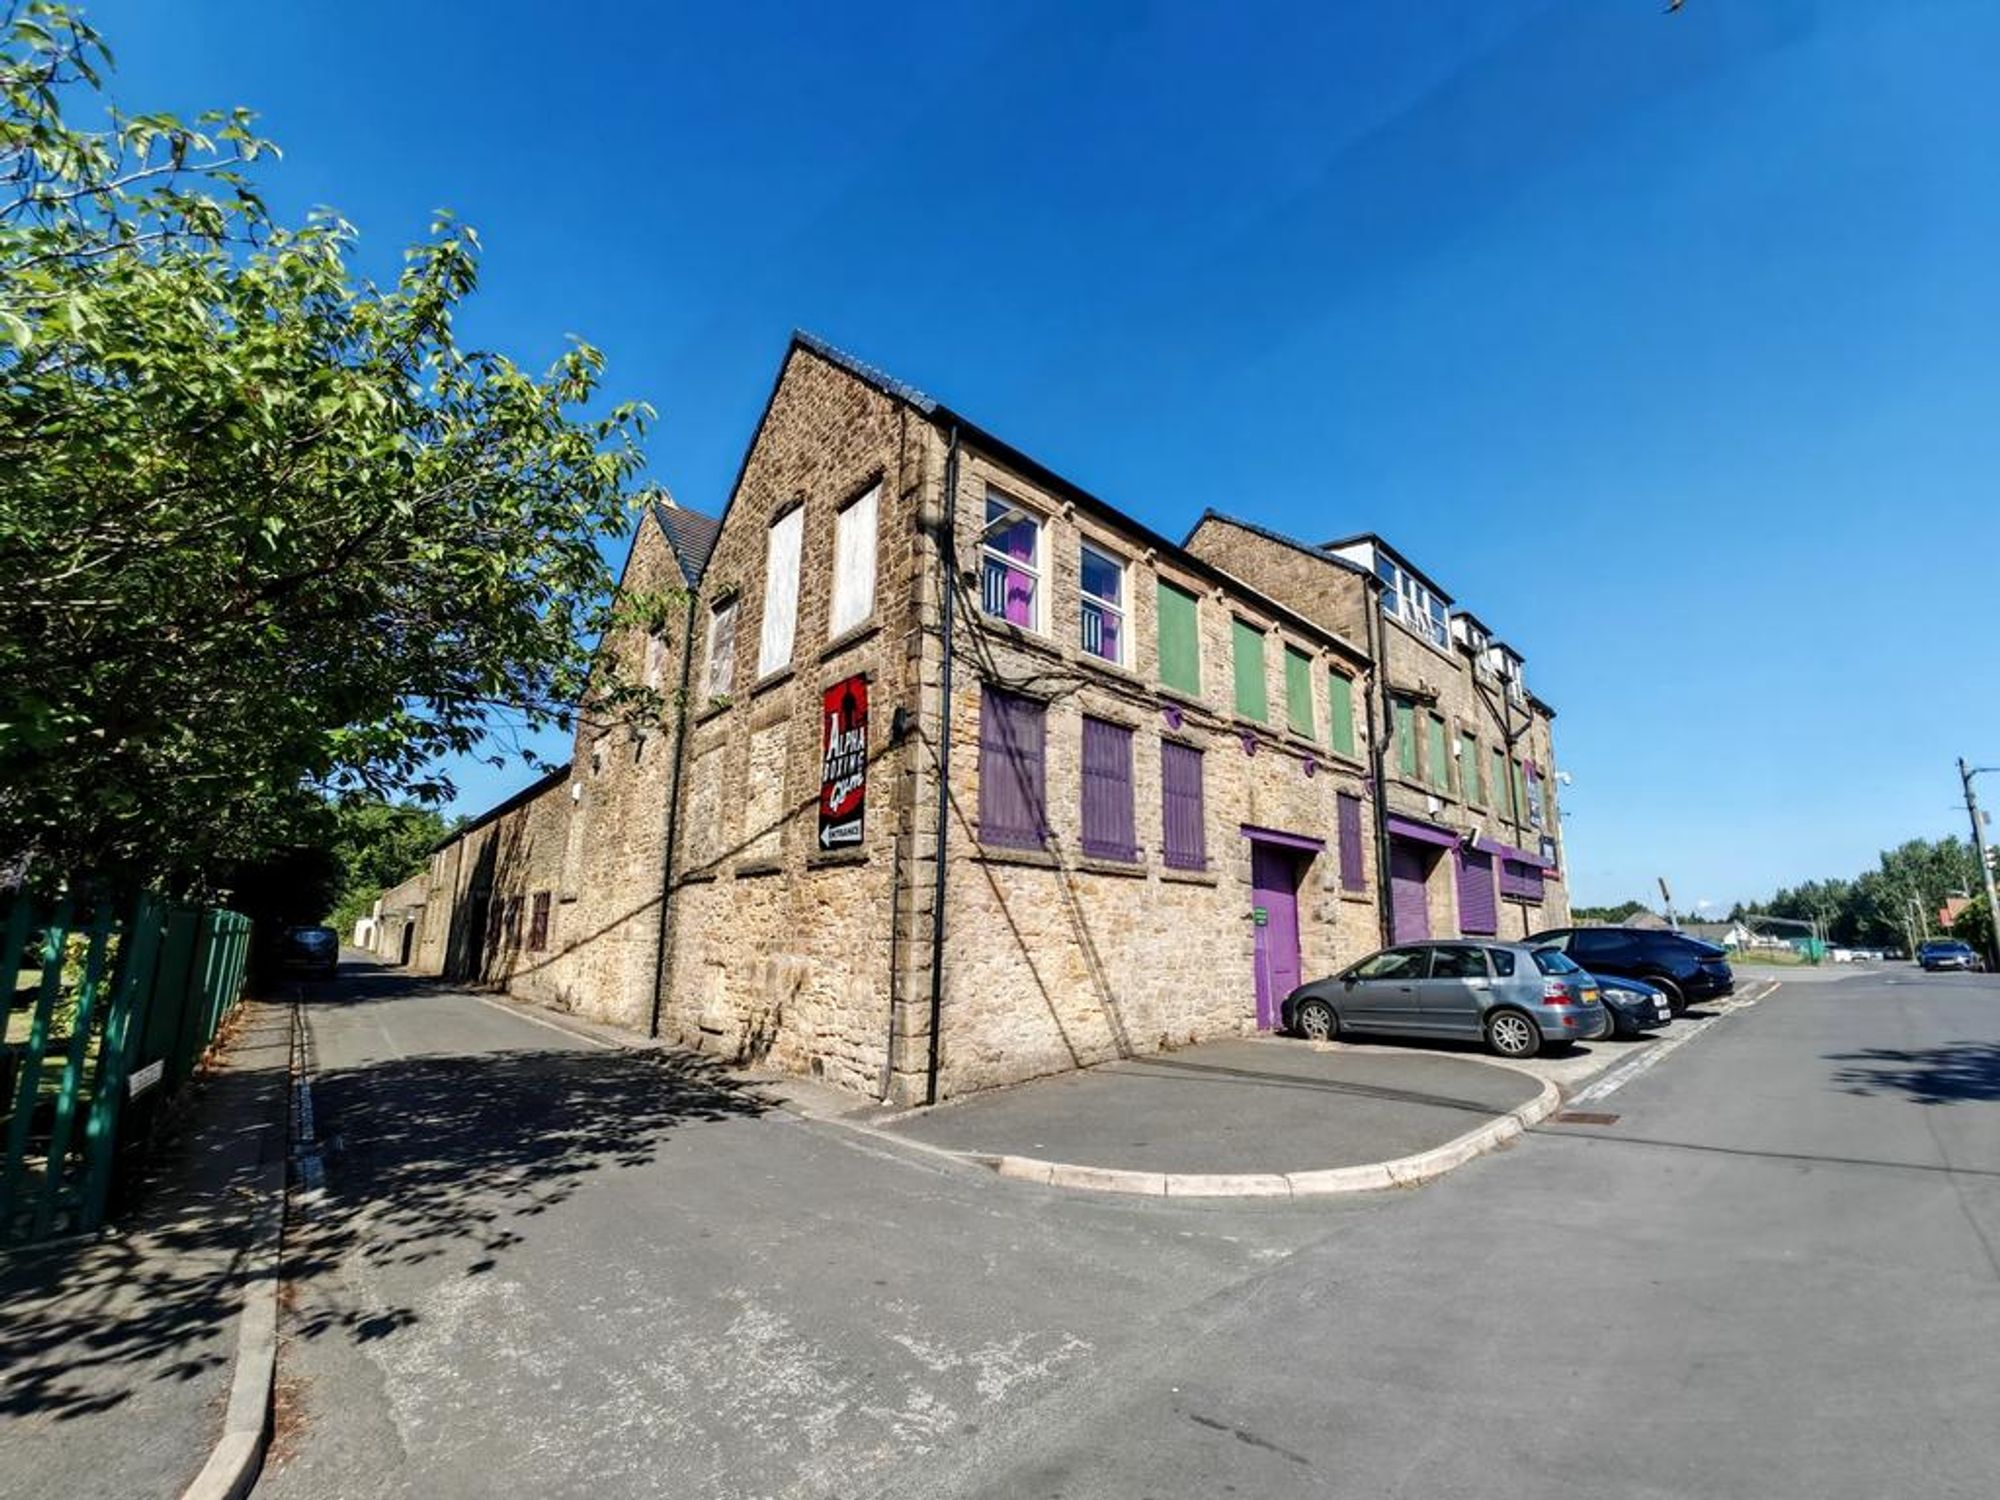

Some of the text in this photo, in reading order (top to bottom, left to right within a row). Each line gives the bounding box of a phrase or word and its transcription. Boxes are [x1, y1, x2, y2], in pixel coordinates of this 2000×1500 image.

[826, 712, 865, 760] ALPHA
[823, 752, 863, 782] BOXING
[828, 826, 859, 838] ENTRANCE
